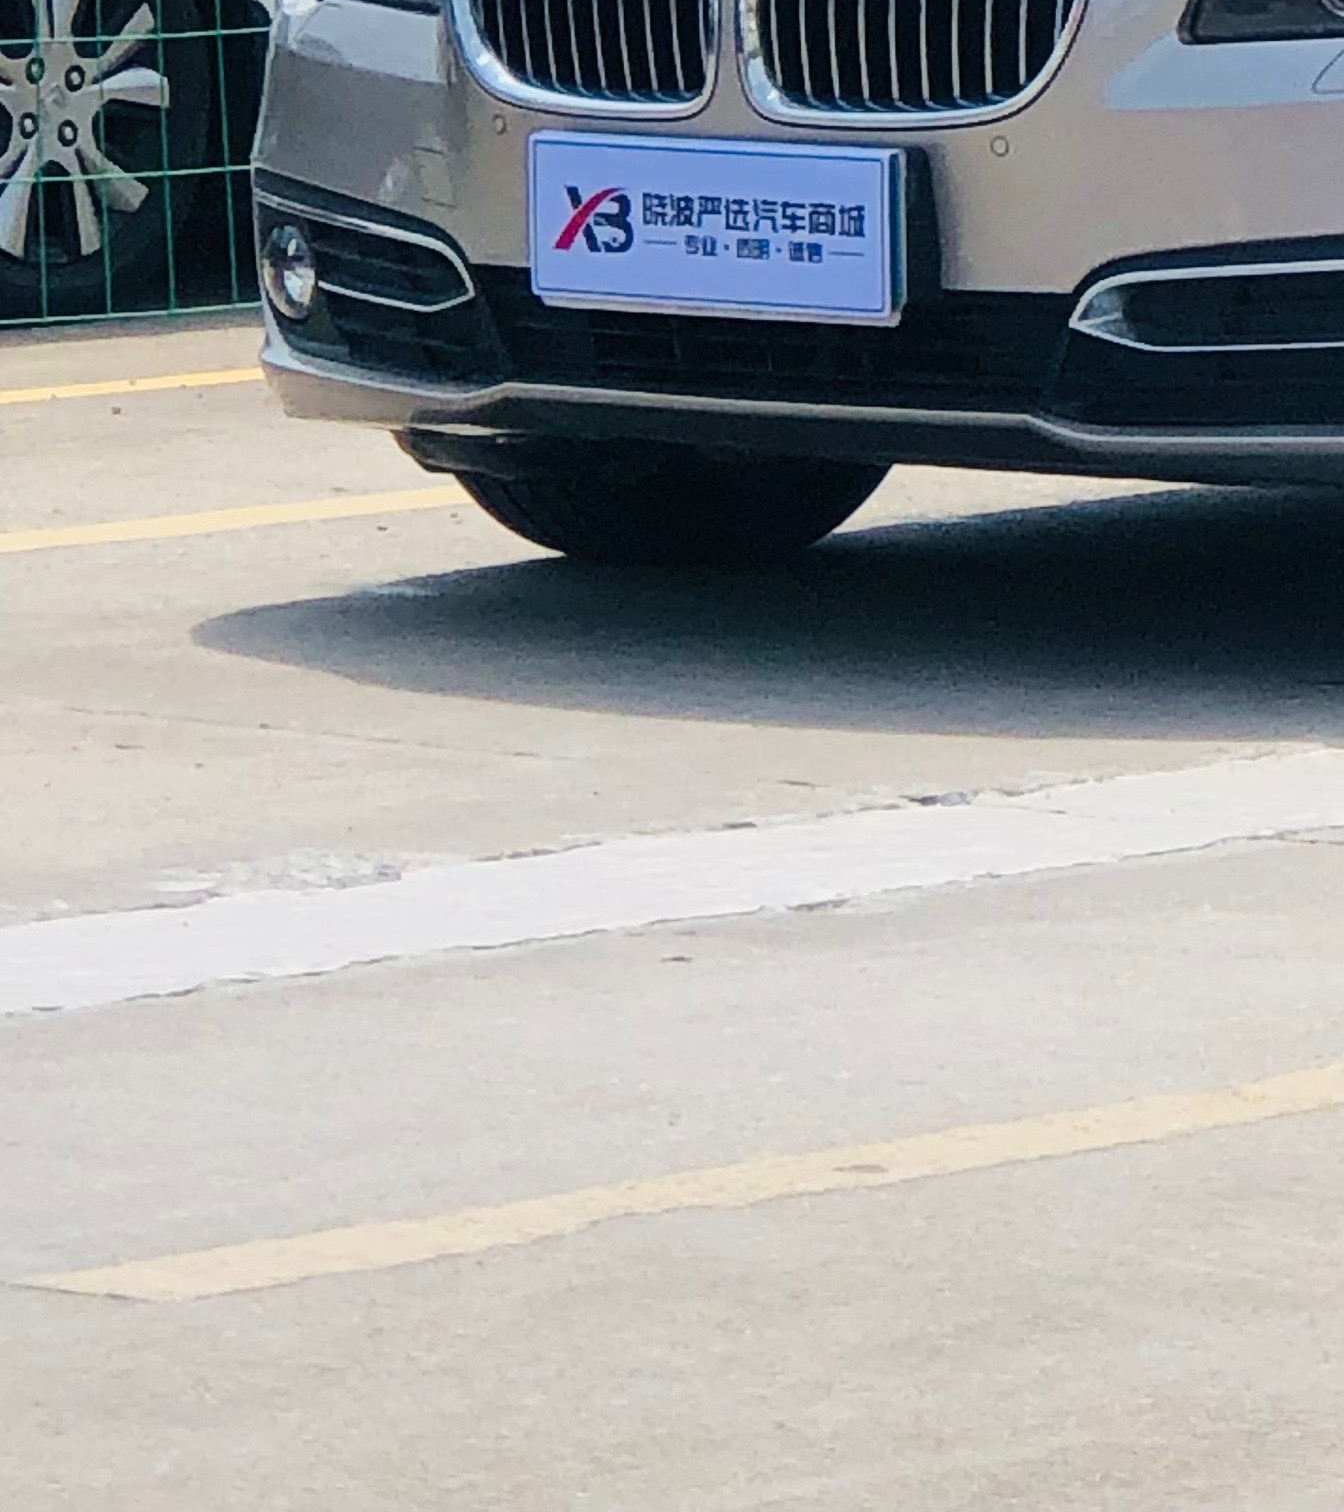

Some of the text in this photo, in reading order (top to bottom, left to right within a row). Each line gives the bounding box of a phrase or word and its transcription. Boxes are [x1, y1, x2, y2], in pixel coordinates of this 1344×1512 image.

[642, 192, 866, 238] 晓波严选汽车商城
